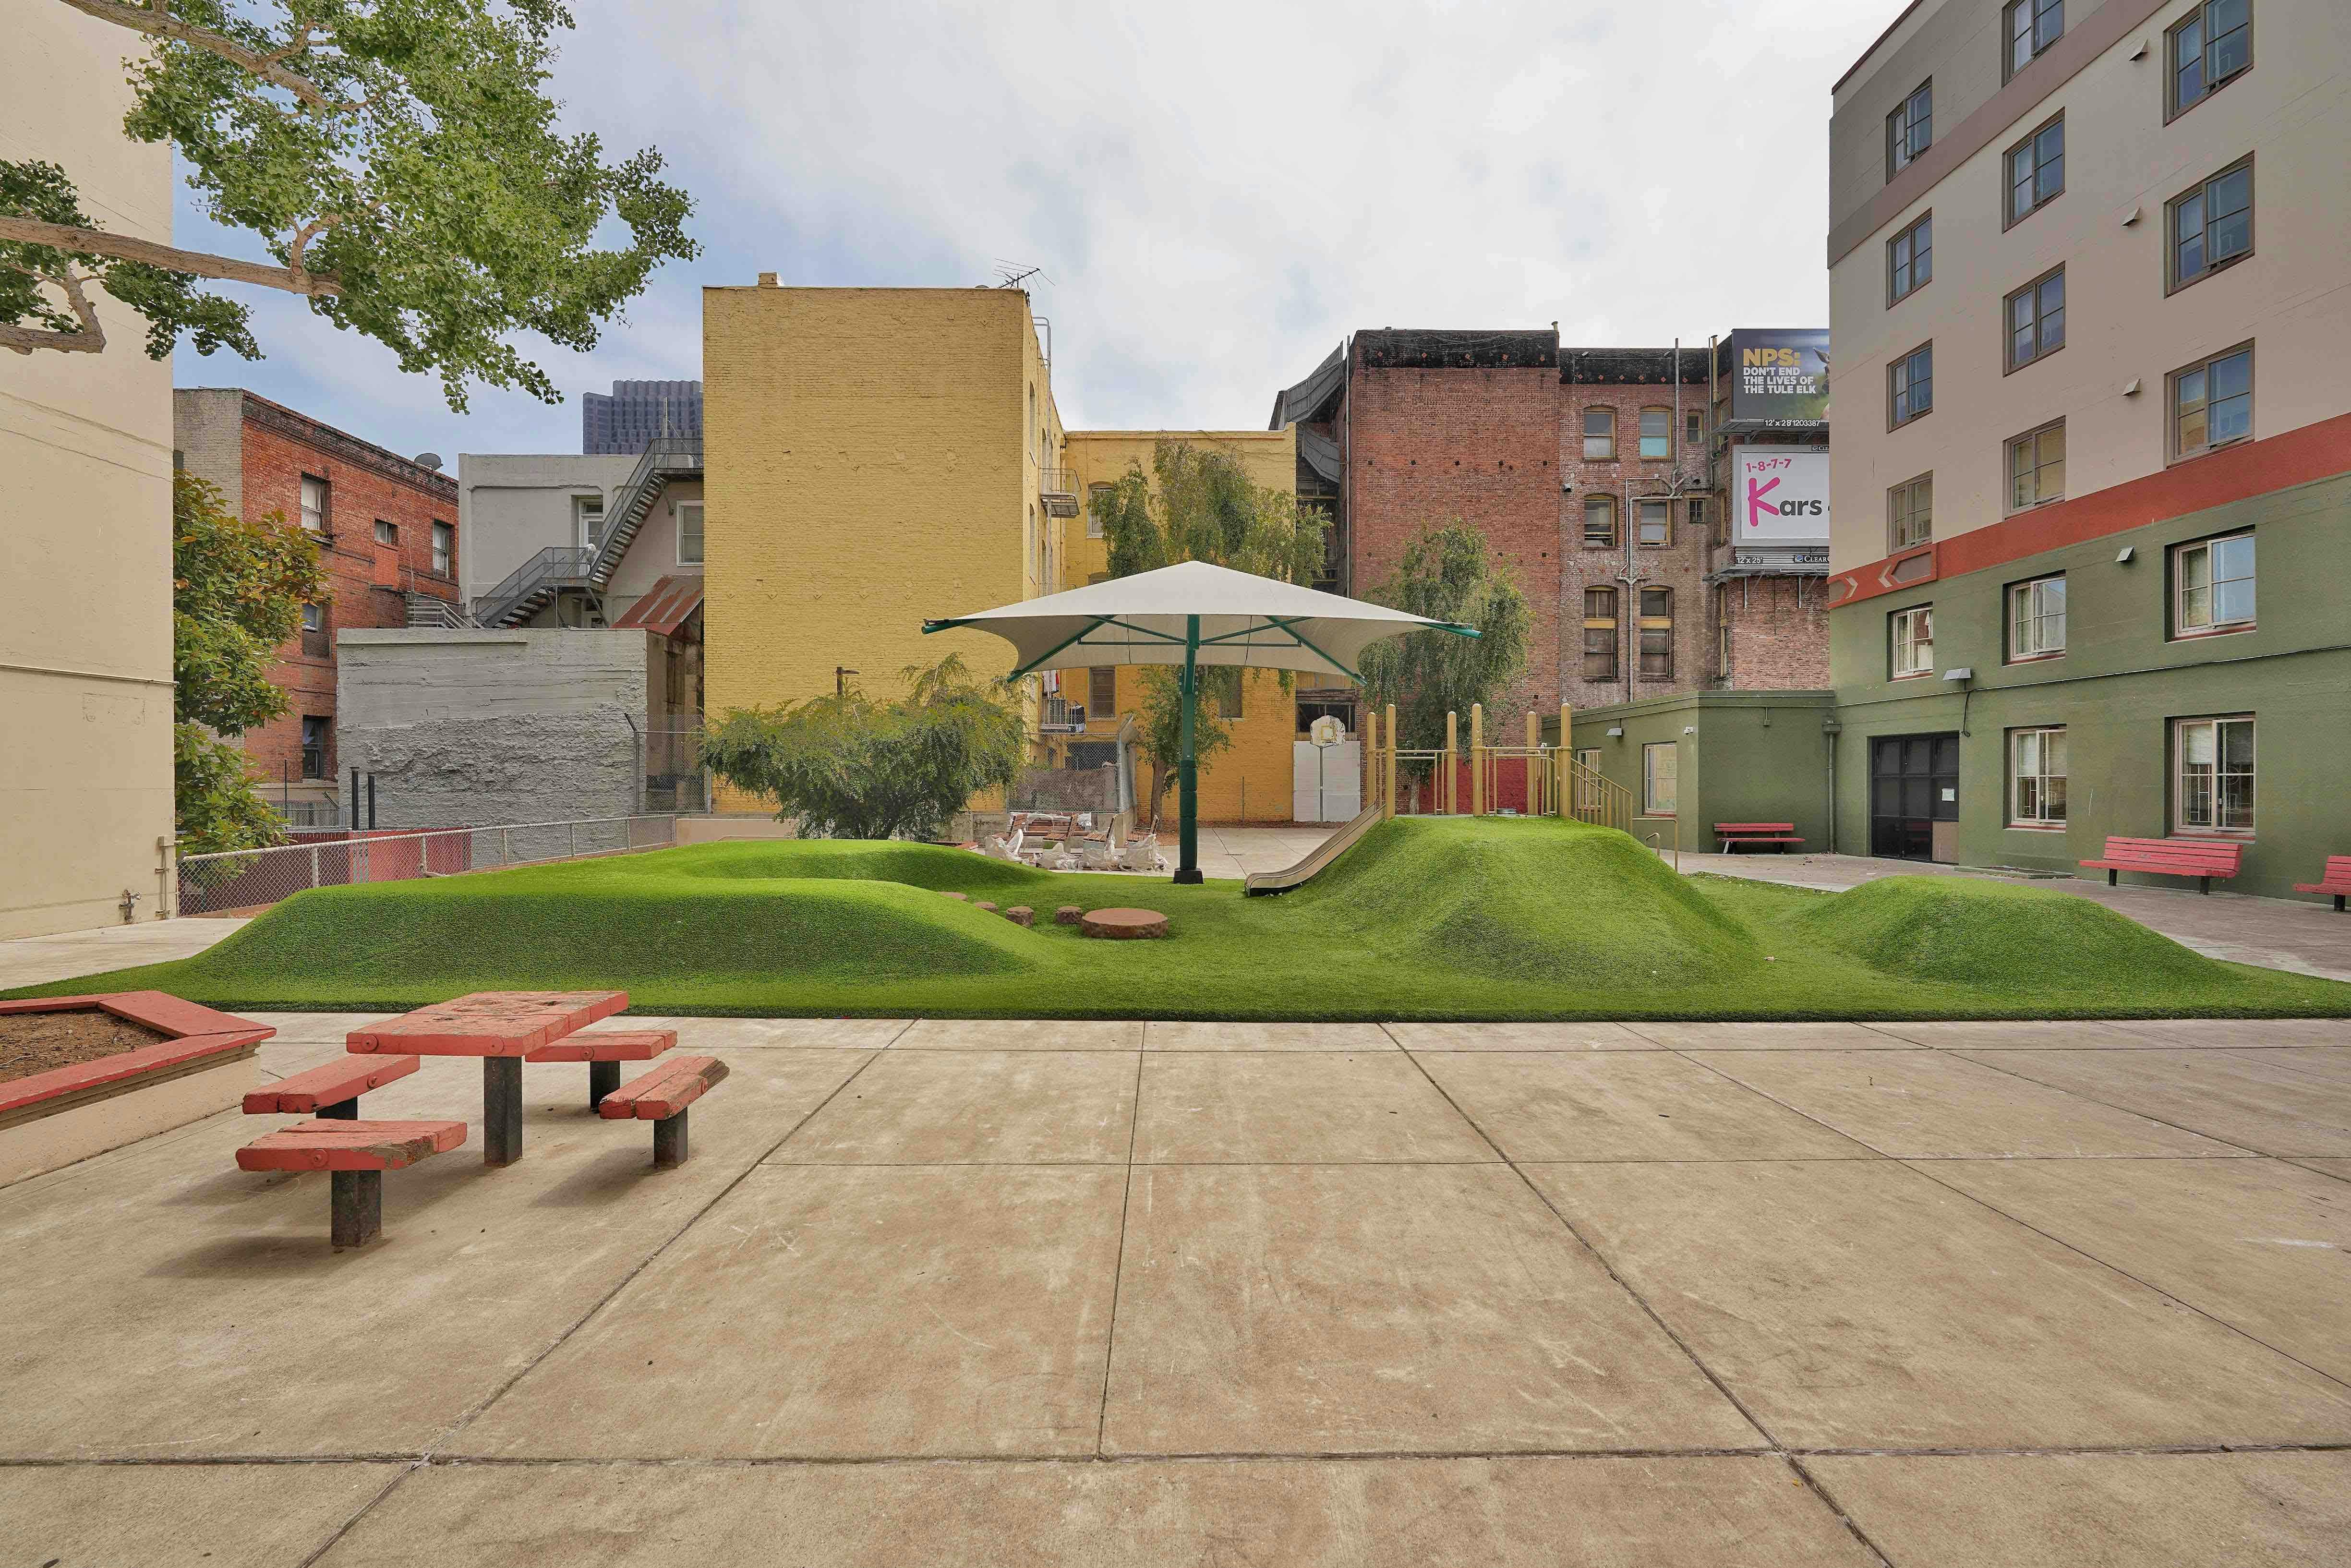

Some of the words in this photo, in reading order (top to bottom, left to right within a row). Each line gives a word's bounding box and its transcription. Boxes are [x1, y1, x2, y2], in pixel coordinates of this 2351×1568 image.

[1744, 349, 1800, 366] NPS:
[1744, 367, 1776, 375] DON'T
[1779, 367, 1800, 375] END
[1744, 376, 1764, 385] THE
[1767, 376, 1796, 385] LIVES
[1800, 376, 1814, 385] OF
[1744, 386, 1764, 394] THE
[1767, 386, 1794, 394] TULE
[1796, 386, 1816, 394] ELK
[1746, 458, 1792, 472] 1-8-7-7
[1748, 477, 1822, 527] Kars
